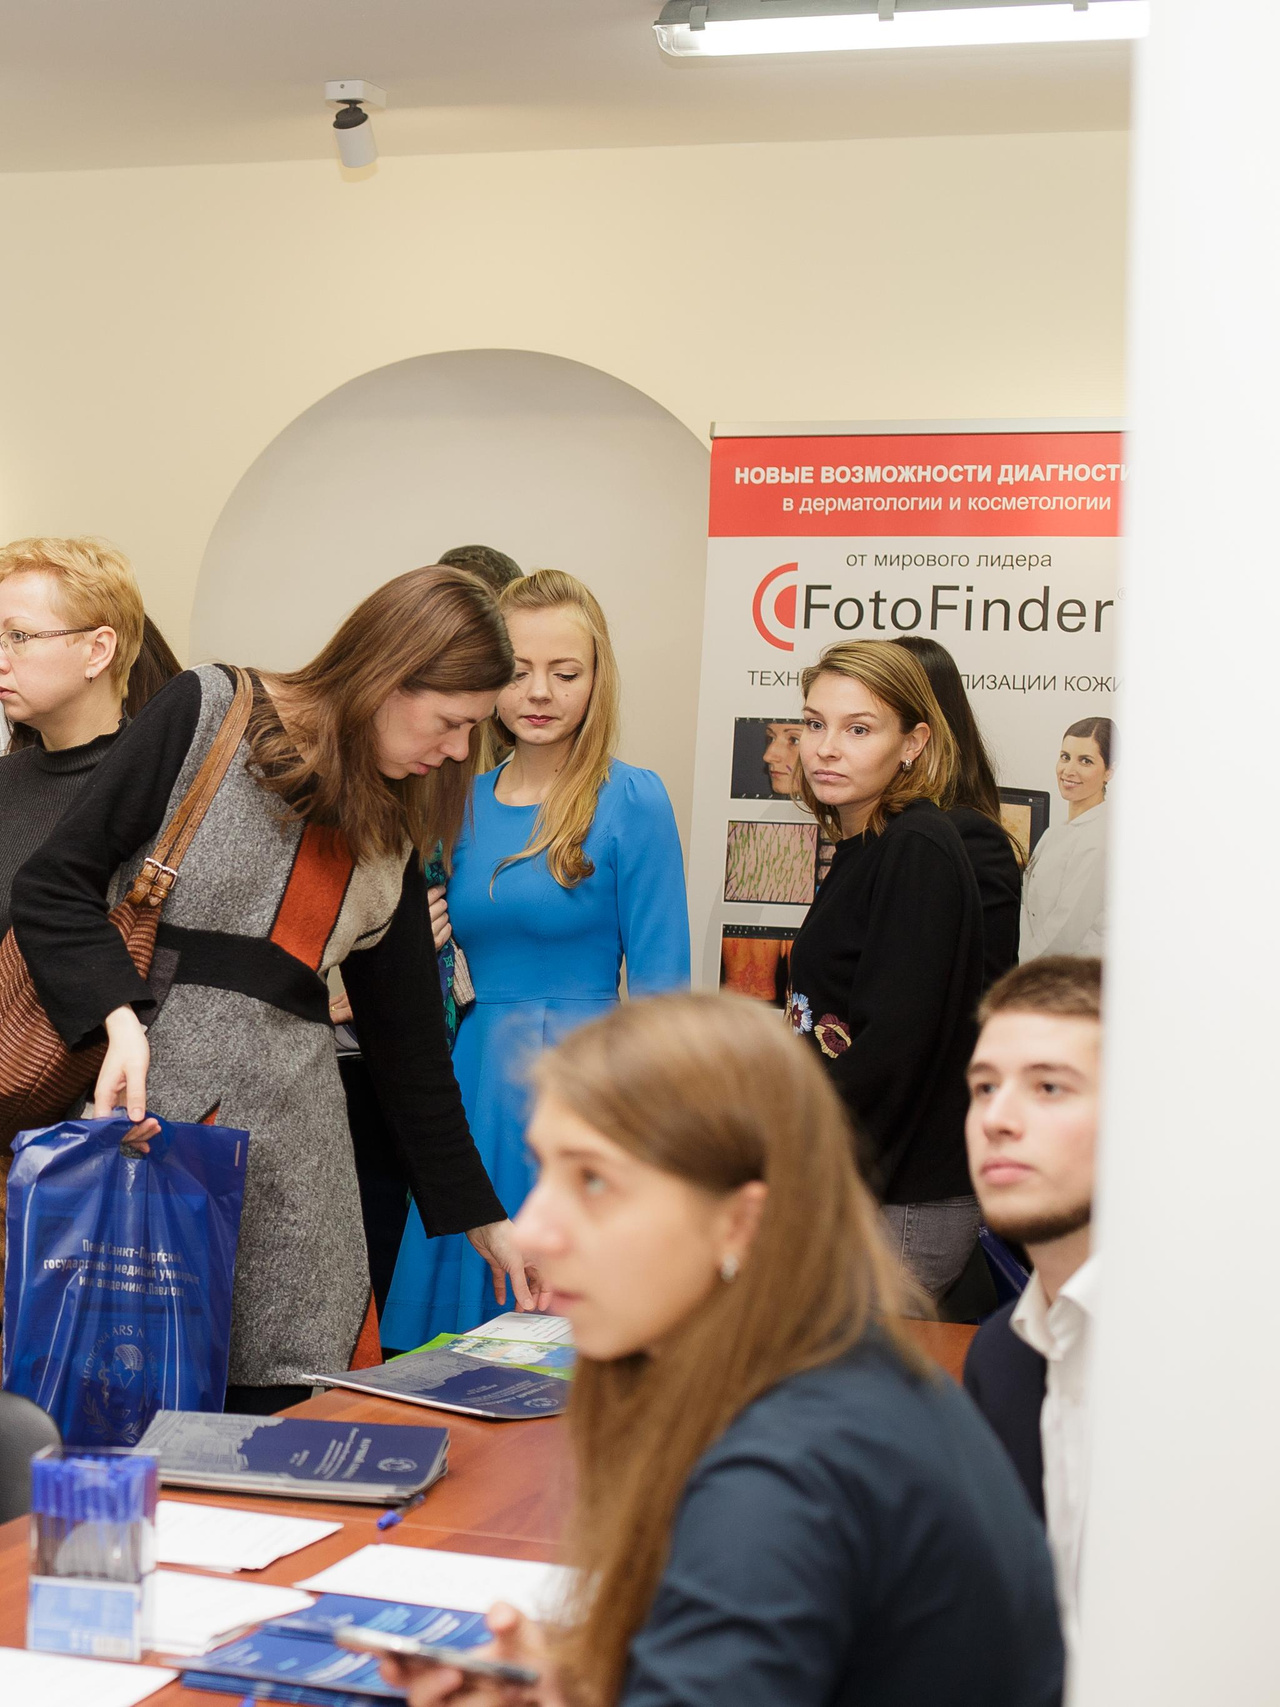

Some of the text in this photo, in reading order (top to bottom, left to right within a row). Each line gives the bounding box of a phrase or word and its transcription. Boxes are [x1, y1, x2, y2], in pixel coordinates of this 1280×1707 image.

[734, 465, 814, 485] НОВЫЕ
[820, 464, 992, 485] ВОЗМОЖНОСТИ
[782, 495, 1111, 516] в дерматологии и косметологии
[846, 553, 1052, 571] от мирового лидера
[803, 583, 1114, 633] FotoFinder
[112, 1325, 133, 1337] ARS
